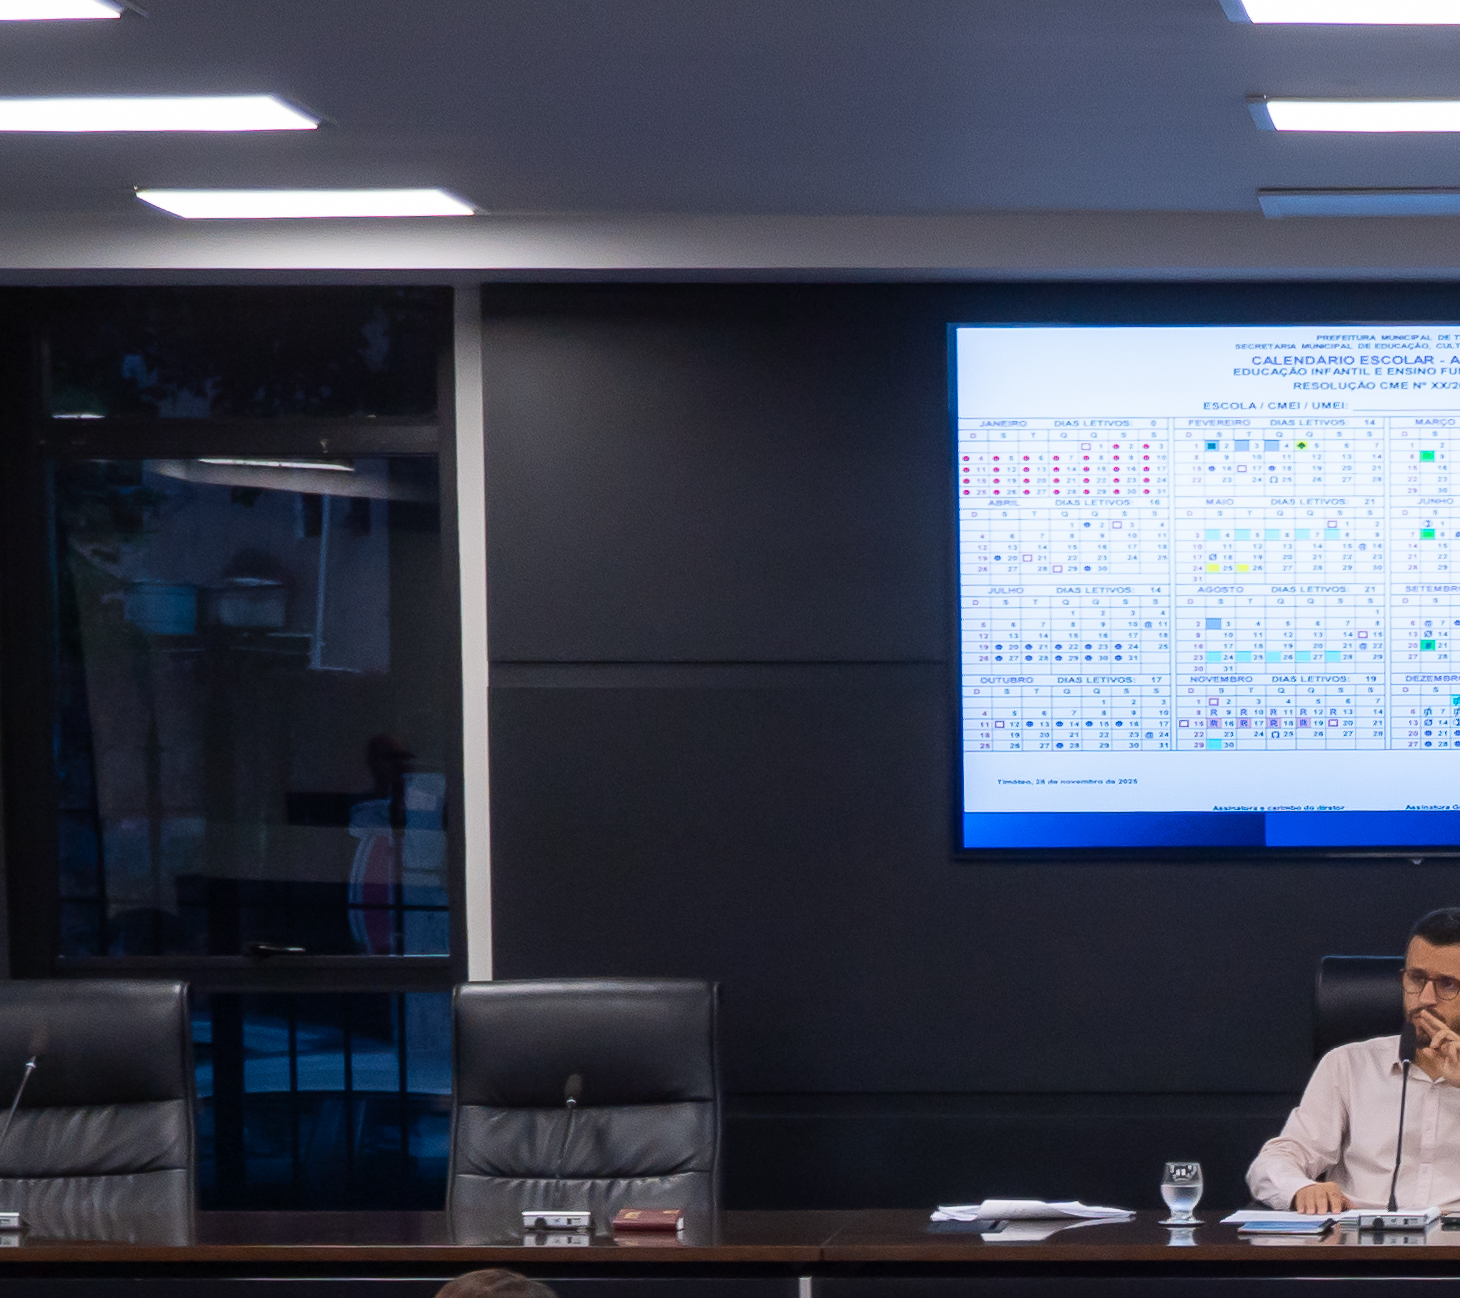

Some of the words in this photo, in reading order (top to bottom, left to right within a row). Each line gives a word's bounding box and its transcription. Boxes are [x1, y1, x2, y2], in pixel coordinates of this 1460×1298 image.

[1360, 355, 1434, 365] ESCOLAR
[1233, 367, 1307, 377] EDUCAÇÃO
[1375, 367, 1382, 375] E
[1387, 367, 1436, 375] ENSINO
[1293, 381, 1376, 391] RESOLUÇÃO
[1203, 402, 1257, 410] ESCOLA
[1188, 418, 1251, 426] FEVEREIRO
[1415, 417, 1455, 427] MARÇO
[988, 586, 1024, 594] JULHO
